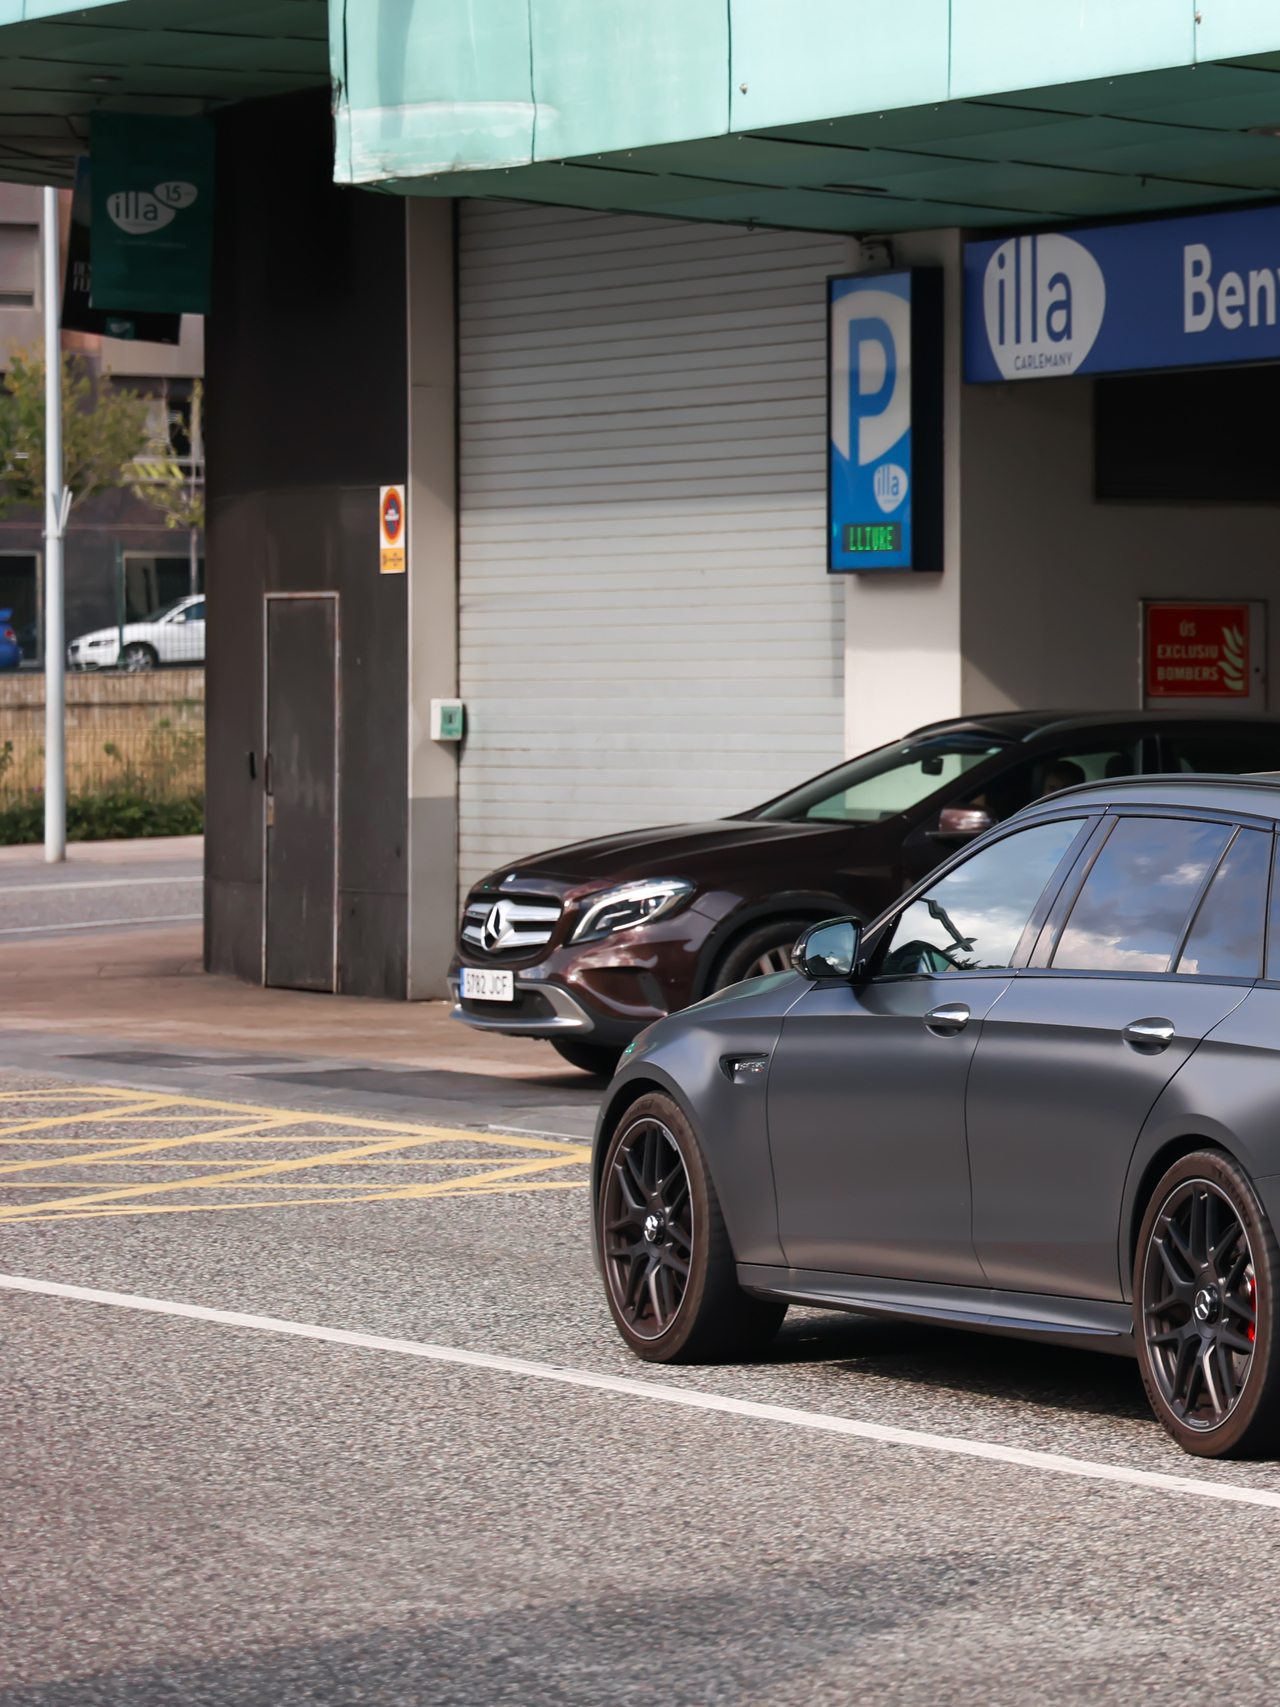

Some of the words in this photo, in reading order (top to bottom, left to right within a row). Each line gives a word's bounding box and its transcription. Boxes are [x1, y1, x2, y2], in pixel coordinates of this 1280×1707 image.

[165, 185, 181, 203] 15
[115, 191, 158, 221] illa
[998, 235, 1073, 346] illa
[1014, 352, 1073, 371] CARLEMANY
[848, 317, 896, 466] P
[877, 464, 899, 497] illa
[1157, 644, 1218, 660] EXCLUSIU
[1157, 666, 1219, 681] BOMBERS
[490, 975, 508, 995] JCF
